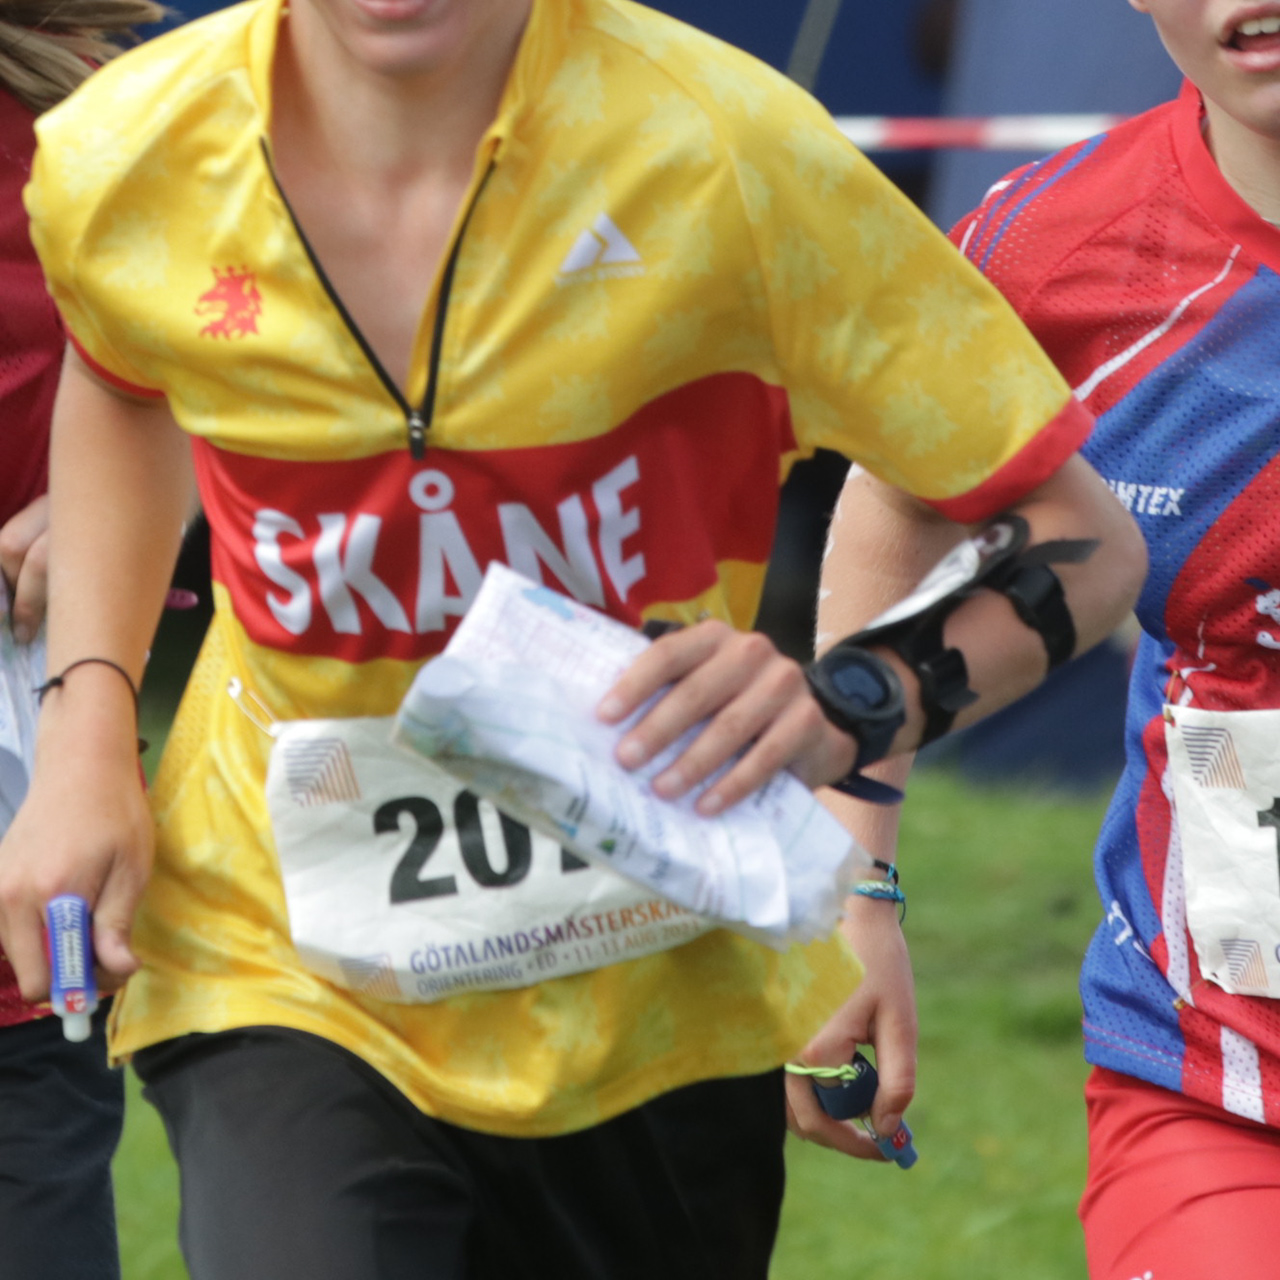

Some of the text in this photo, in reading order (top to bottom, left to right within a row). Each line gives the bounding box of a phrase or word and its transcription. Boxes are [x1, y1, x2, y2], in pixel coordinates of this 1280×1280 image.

[1101, 478, 1185, 517] MTEX
[252, 454, 646, 636] SKÅNE
[373, 788, 591, 905] 20
[410, 898, 690, 975] GÖTALANDSMÄSTERSKA
[416, 962, 523, 996] ORIENTERING
[536, 951, 558, 972] ED
[574, 941, 620, 965] 11-13
